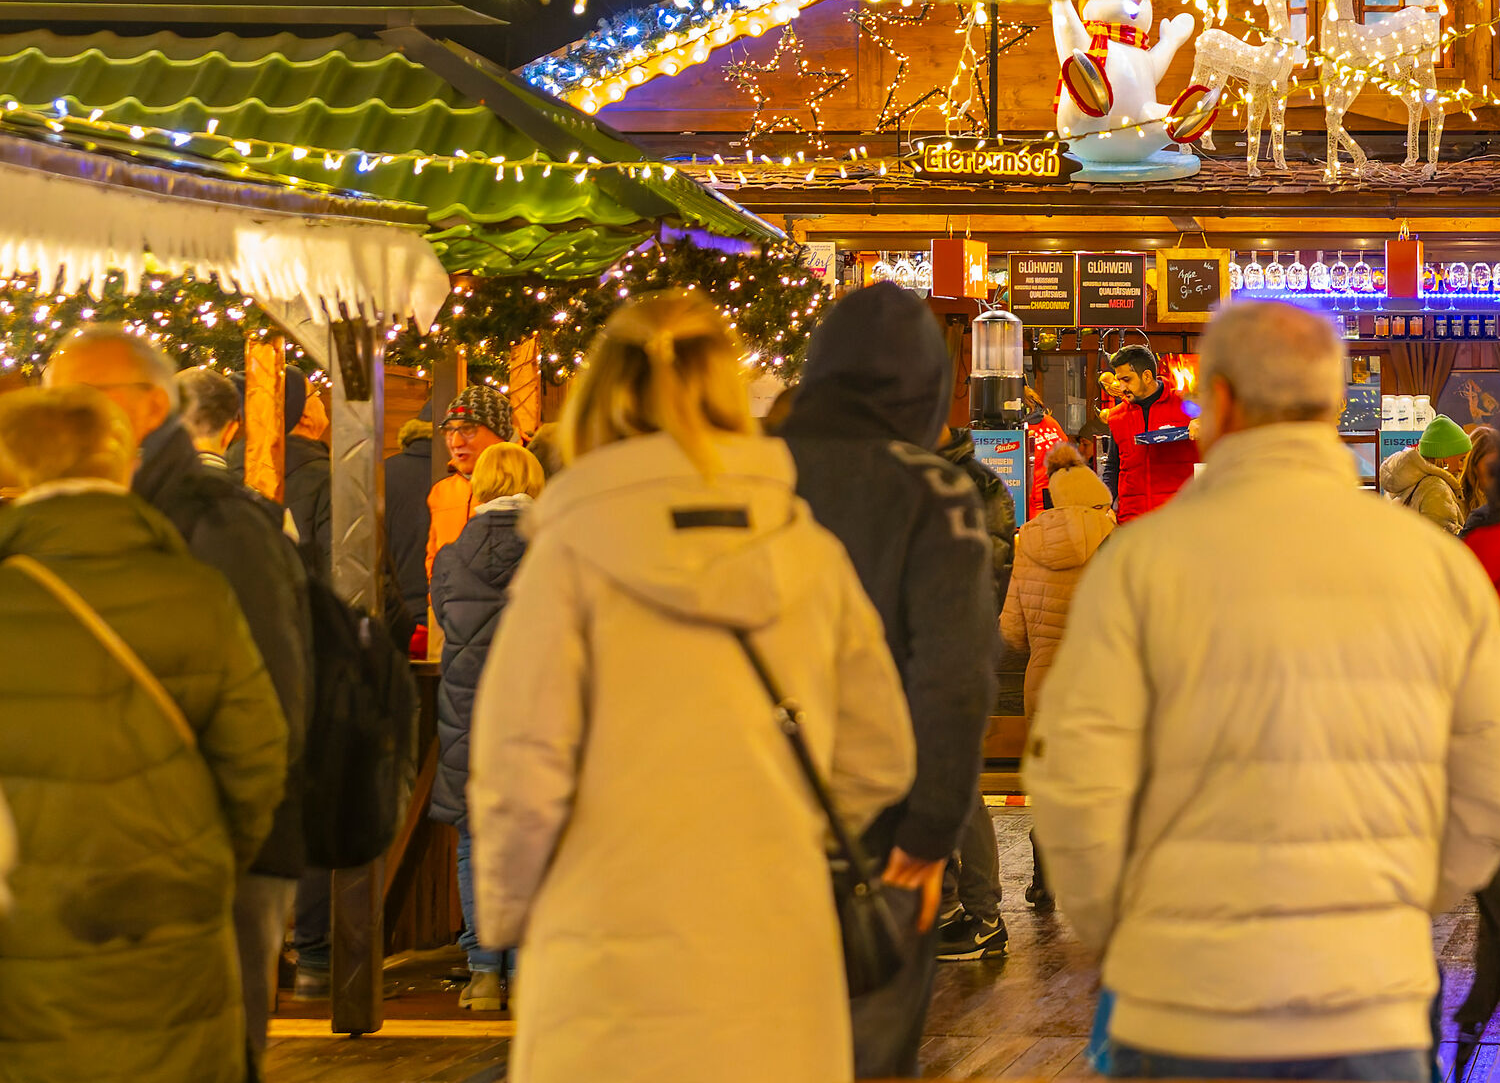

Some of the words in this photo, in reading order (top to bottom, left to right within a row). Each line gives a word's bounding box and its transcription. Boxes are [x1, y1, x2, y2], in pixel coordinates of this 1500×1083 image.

[924, 145, 1060, 177] Eierpunsch
[1018, 259, 1063, 274] GLÜHWEIN
[1087, 259, 1133, 274] GLÜHWEIN
[1108, 299, 1135, 309] MERLOT
